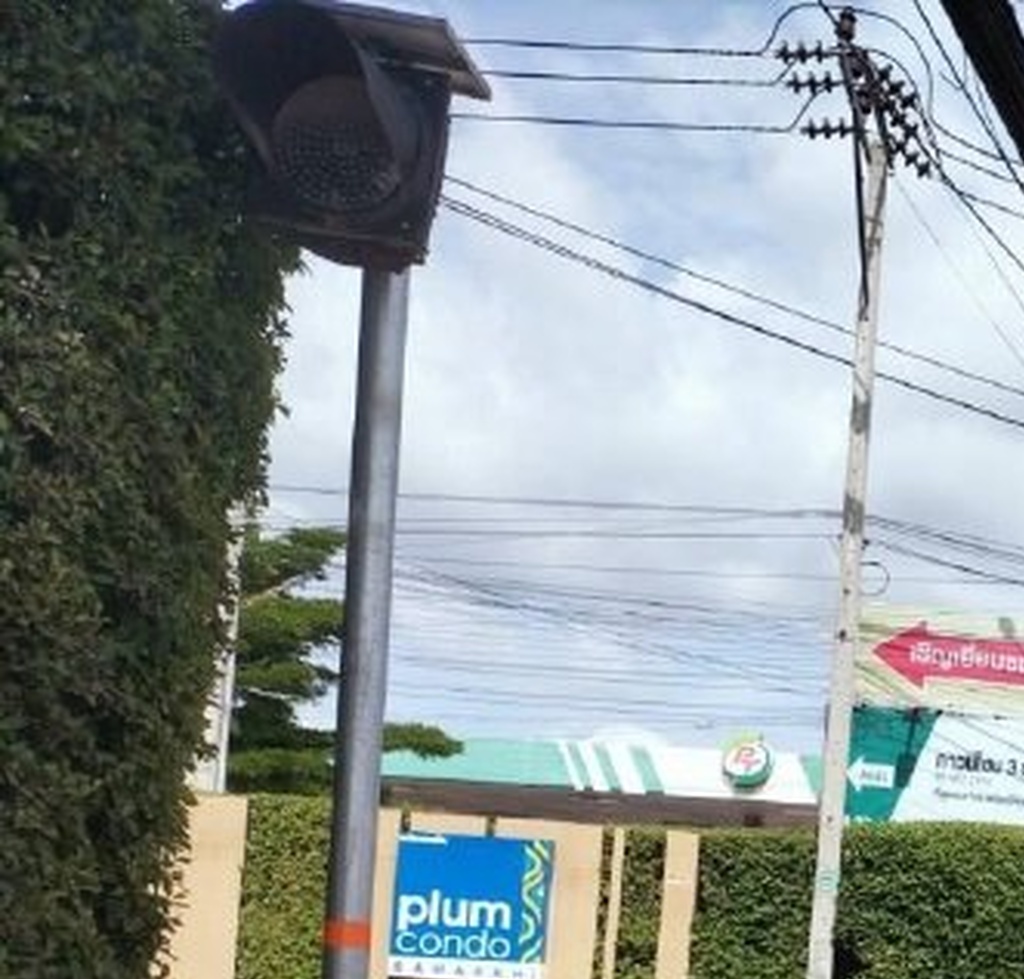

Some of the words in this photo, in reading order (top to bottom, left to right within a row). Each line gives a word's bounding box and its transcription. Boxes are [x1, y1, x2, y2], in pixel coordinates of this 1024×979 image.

[1006, 758, 1017, 777] 3
[398, 889, 511, 930] plum
[396, 930, 511, 958] condo
